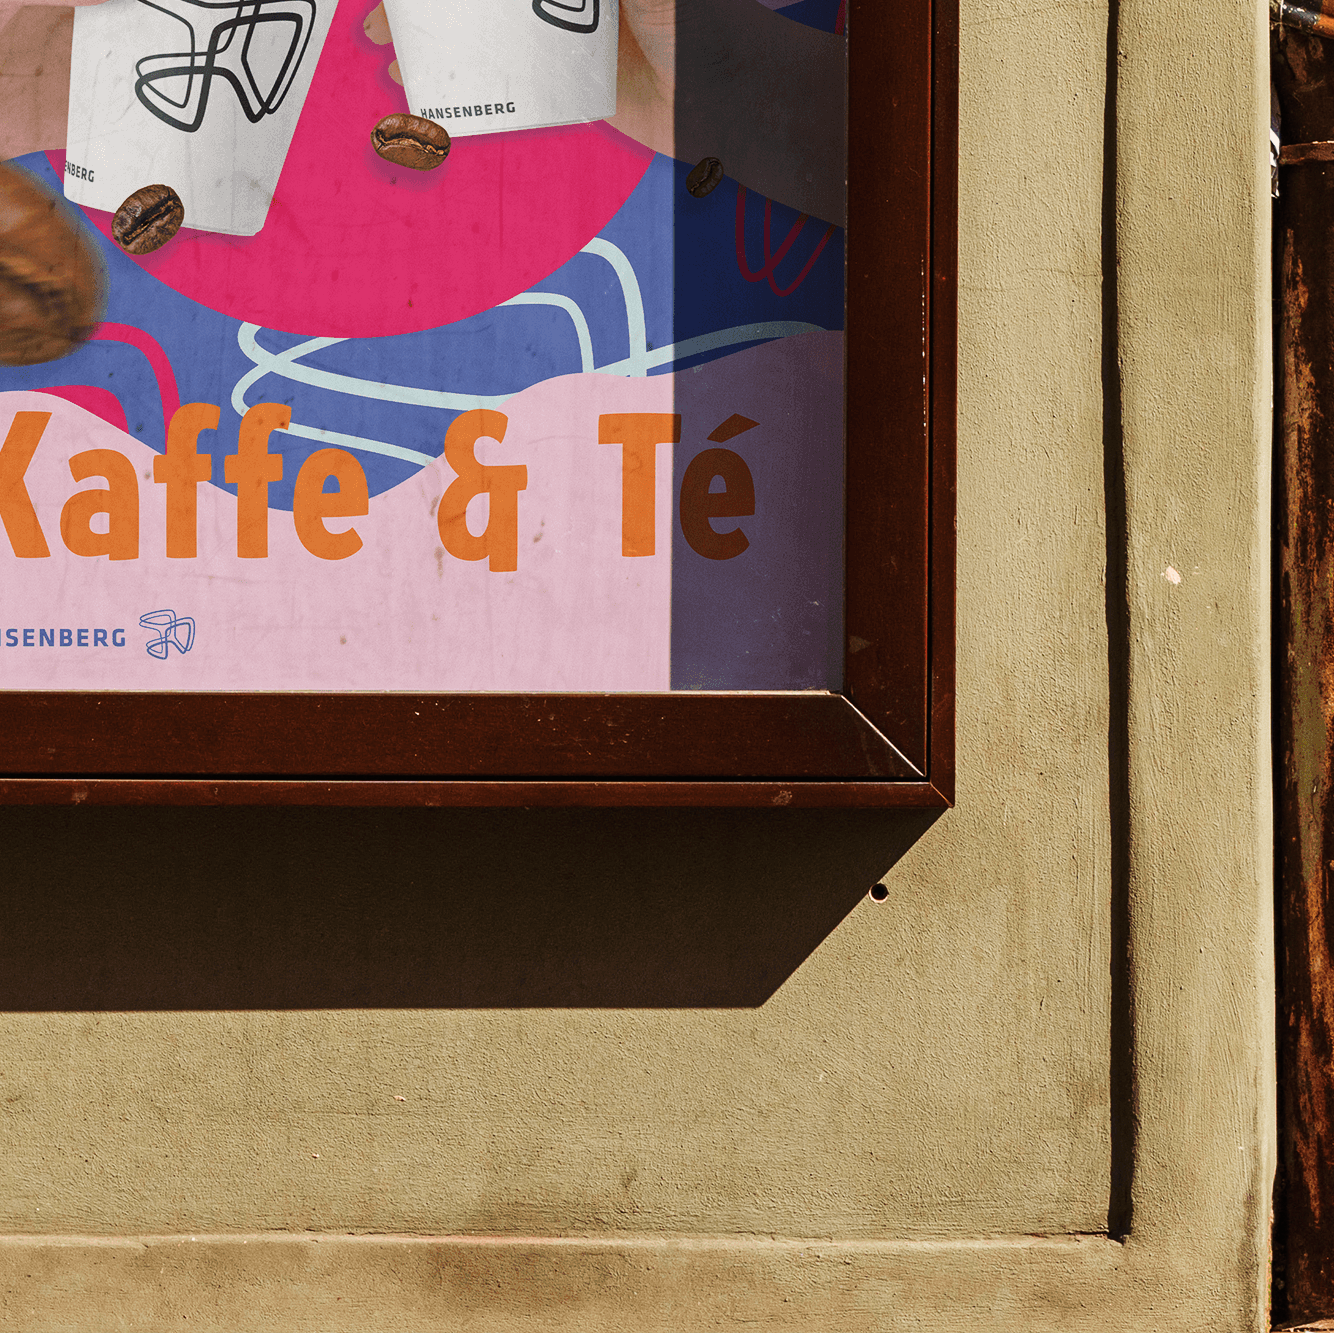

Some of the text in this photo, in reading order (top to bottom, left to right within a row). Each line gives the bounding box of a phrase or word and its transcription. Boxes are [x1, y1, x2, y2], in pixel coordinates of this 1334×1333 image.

[420, 102, 516, 120] HANSENBERG
[436, 408, 528, 573] &
[597, 411, 760, 561] Té
